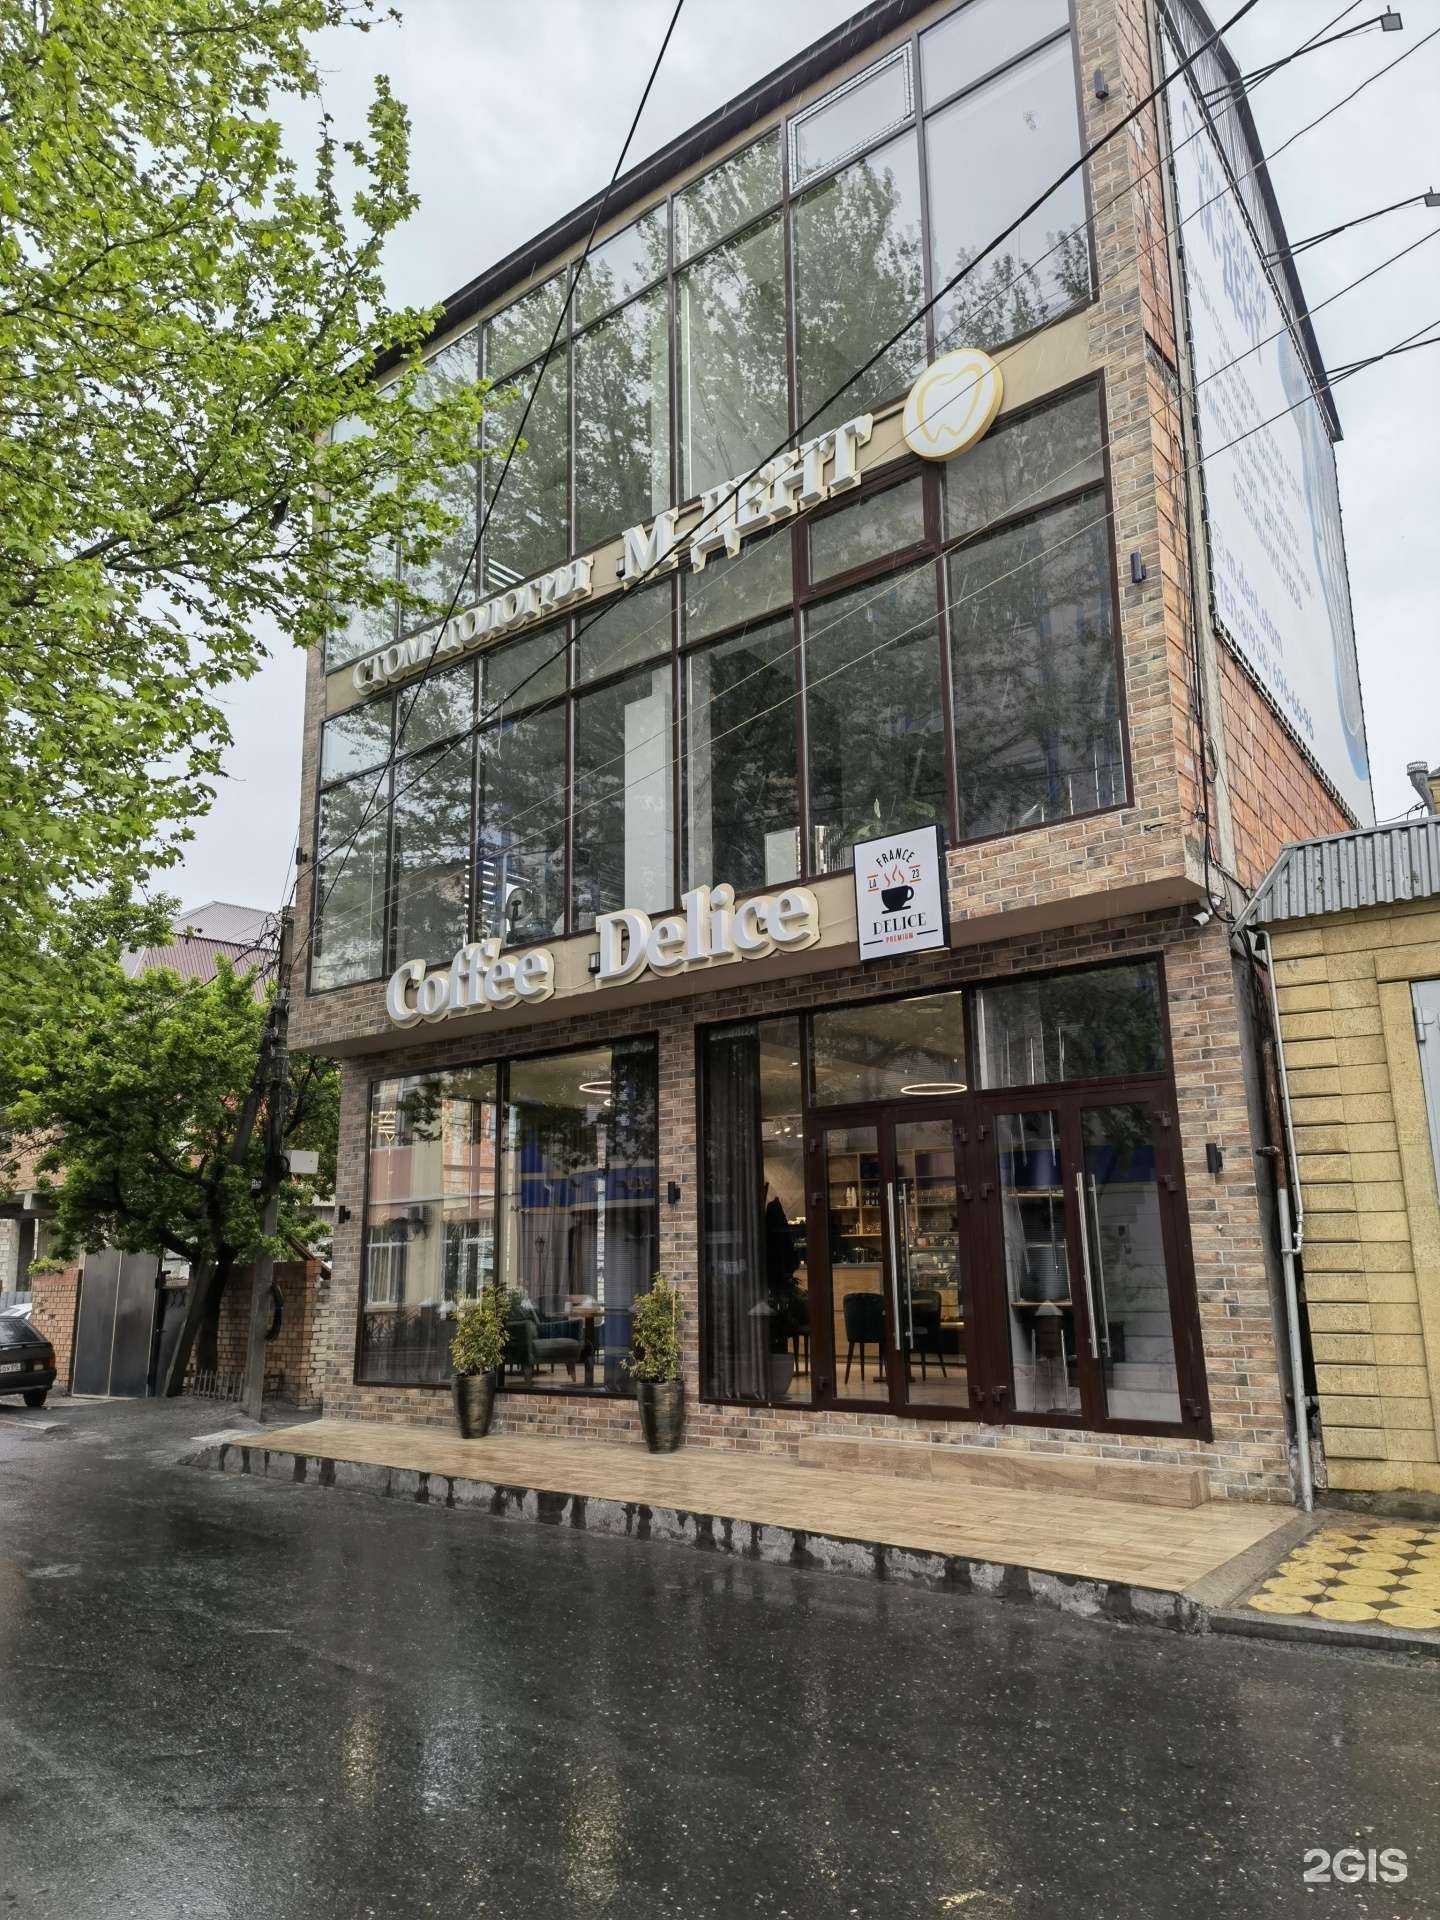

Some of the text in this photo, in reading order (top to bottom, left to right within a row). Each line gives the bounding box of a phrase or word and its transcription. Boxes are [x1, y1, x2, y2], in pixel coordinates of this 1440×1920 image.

[622, 413, 874, 590] М-ДЕНТ
[876, 848, 915, 868] FRANCE
[912, 869, 920, 879] 23
[873, 912, 927, 935] DELICE
[885, 933, 914, 944] PREMIUM
[386, 883, 820, 1029] Coffee Delice
